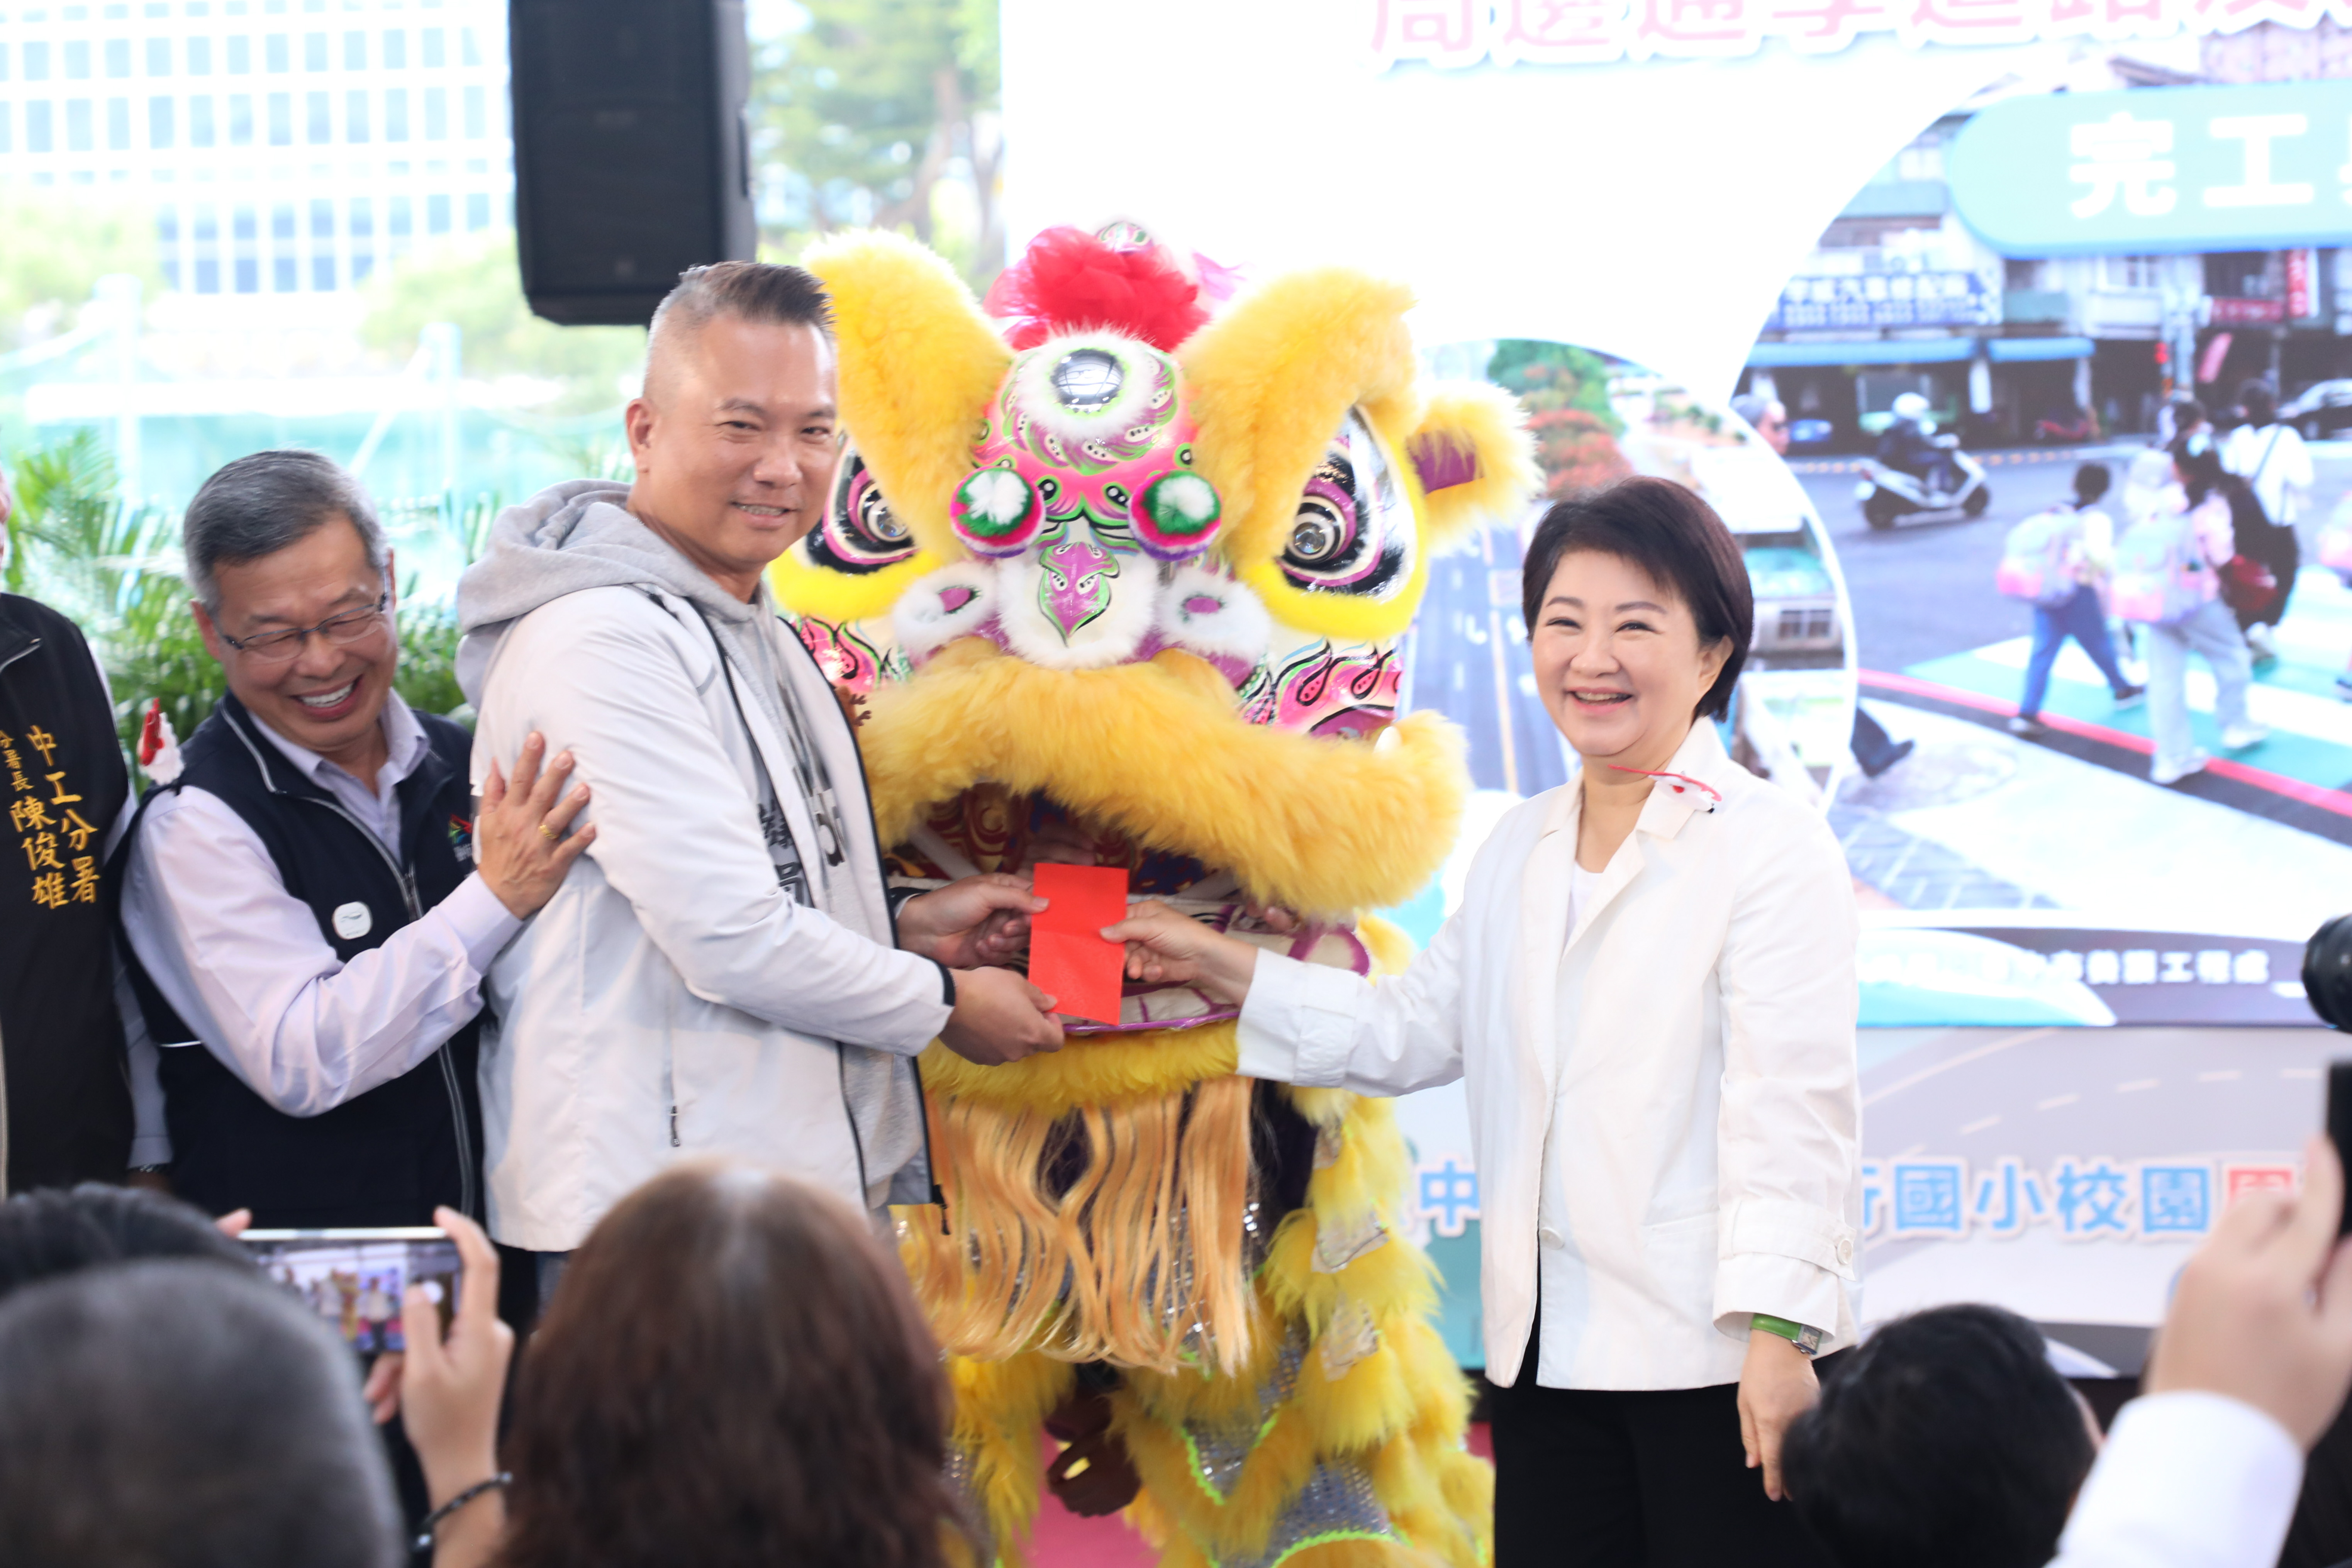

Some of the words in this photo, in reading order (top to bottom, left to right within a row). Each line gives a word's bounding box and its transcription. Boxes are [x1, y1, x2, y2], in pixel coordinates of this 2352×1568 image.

[2069, 111, 2352, 219] 完工
[25, 724, 101, 904] 中工分署
